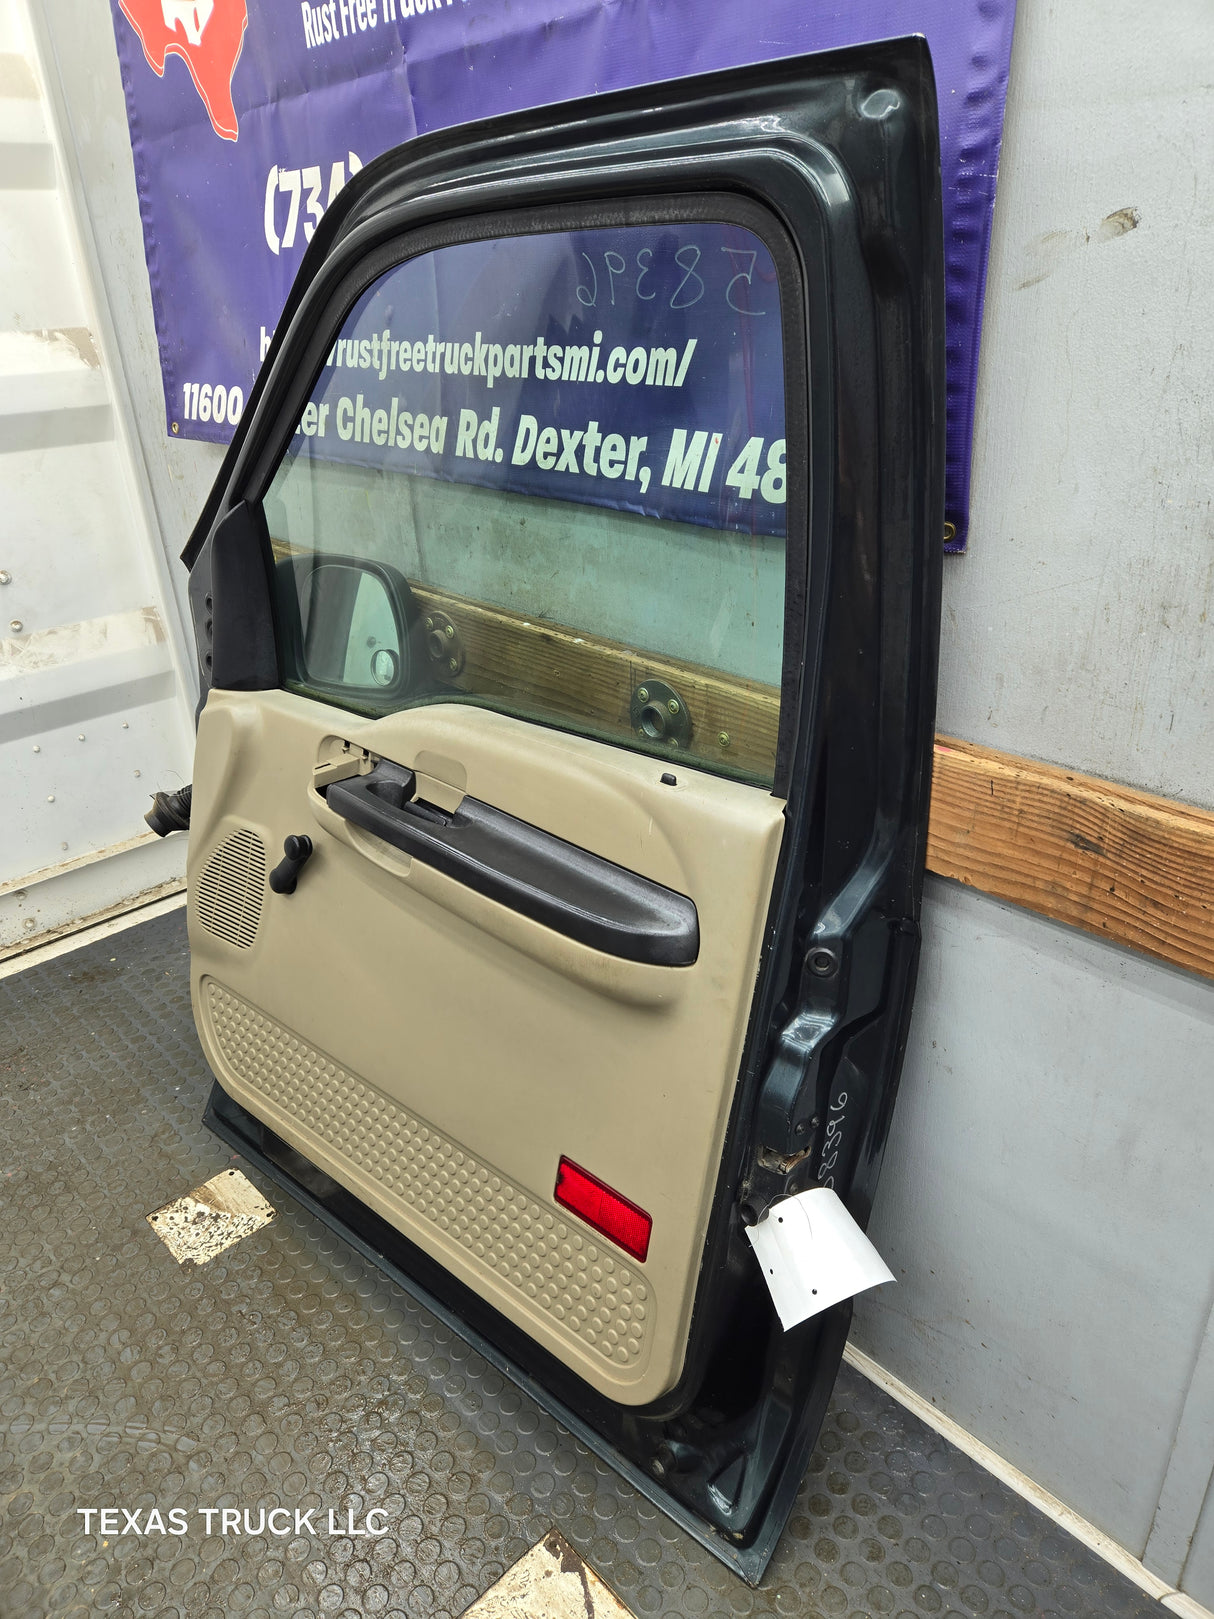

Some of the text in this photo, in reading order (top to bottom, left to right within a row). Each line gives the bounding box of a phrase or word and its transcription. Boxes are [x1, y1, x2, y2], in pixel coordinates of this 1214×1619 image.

[301, 1, 340, 49] Rust
[338, 0, 378, 38] Free
[183, 383, 244, 425] 11600
[336, 394, 448, 455] Chelsea
[455, 406, 504, 463] Rd.
[511, 414, 652, 494] Dexter,
[661, 428, 724, 493] MI
